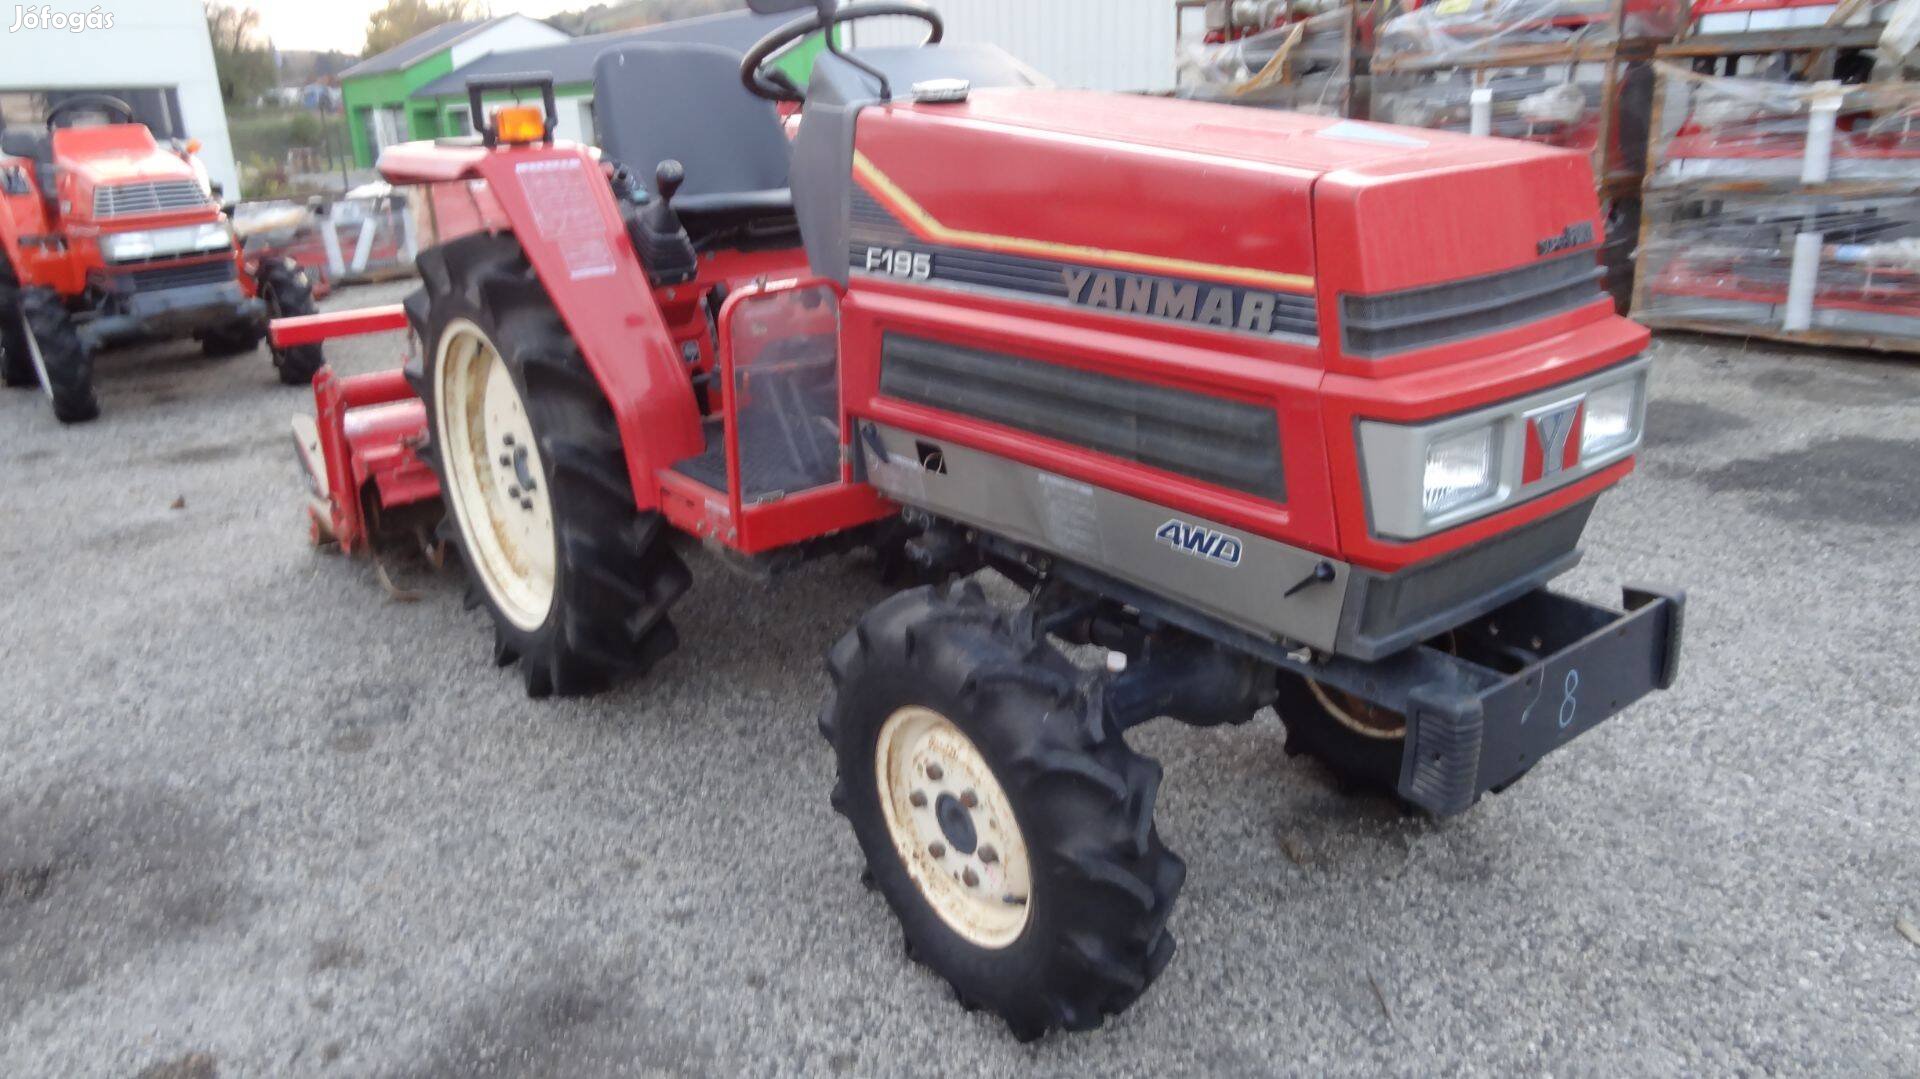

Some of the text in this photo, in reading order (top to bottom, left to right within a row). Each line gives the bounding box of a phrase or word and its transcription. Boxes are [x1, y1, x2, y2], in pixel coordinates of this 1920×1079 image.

[865, 246, 931, 280] F195
[1061, 267, 1277, 333] YANMAR
[1155, 518, 1242, 568] 4WD
